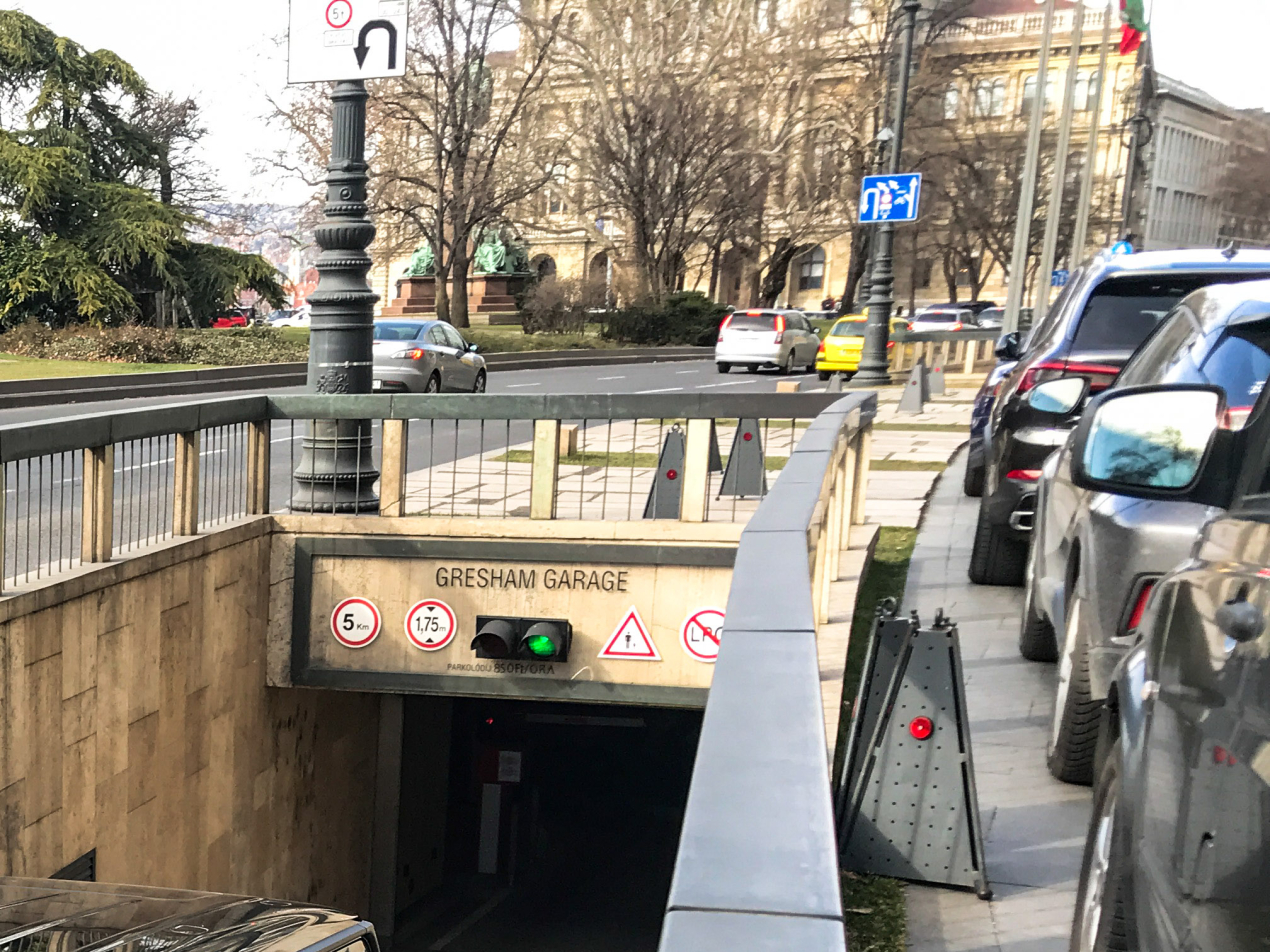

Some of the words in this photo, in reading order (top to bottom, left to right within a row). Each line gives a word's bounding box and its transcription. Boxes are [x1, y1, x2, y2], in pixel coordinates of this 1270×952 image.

[332, 7, 339, 20] 5
[435, 567, 536, 590] GRESHAM
[543, 568, 629, 592] GARAGE
[342, 613, 354, 631] 5
[416, 616, 439, 635] 1,75
